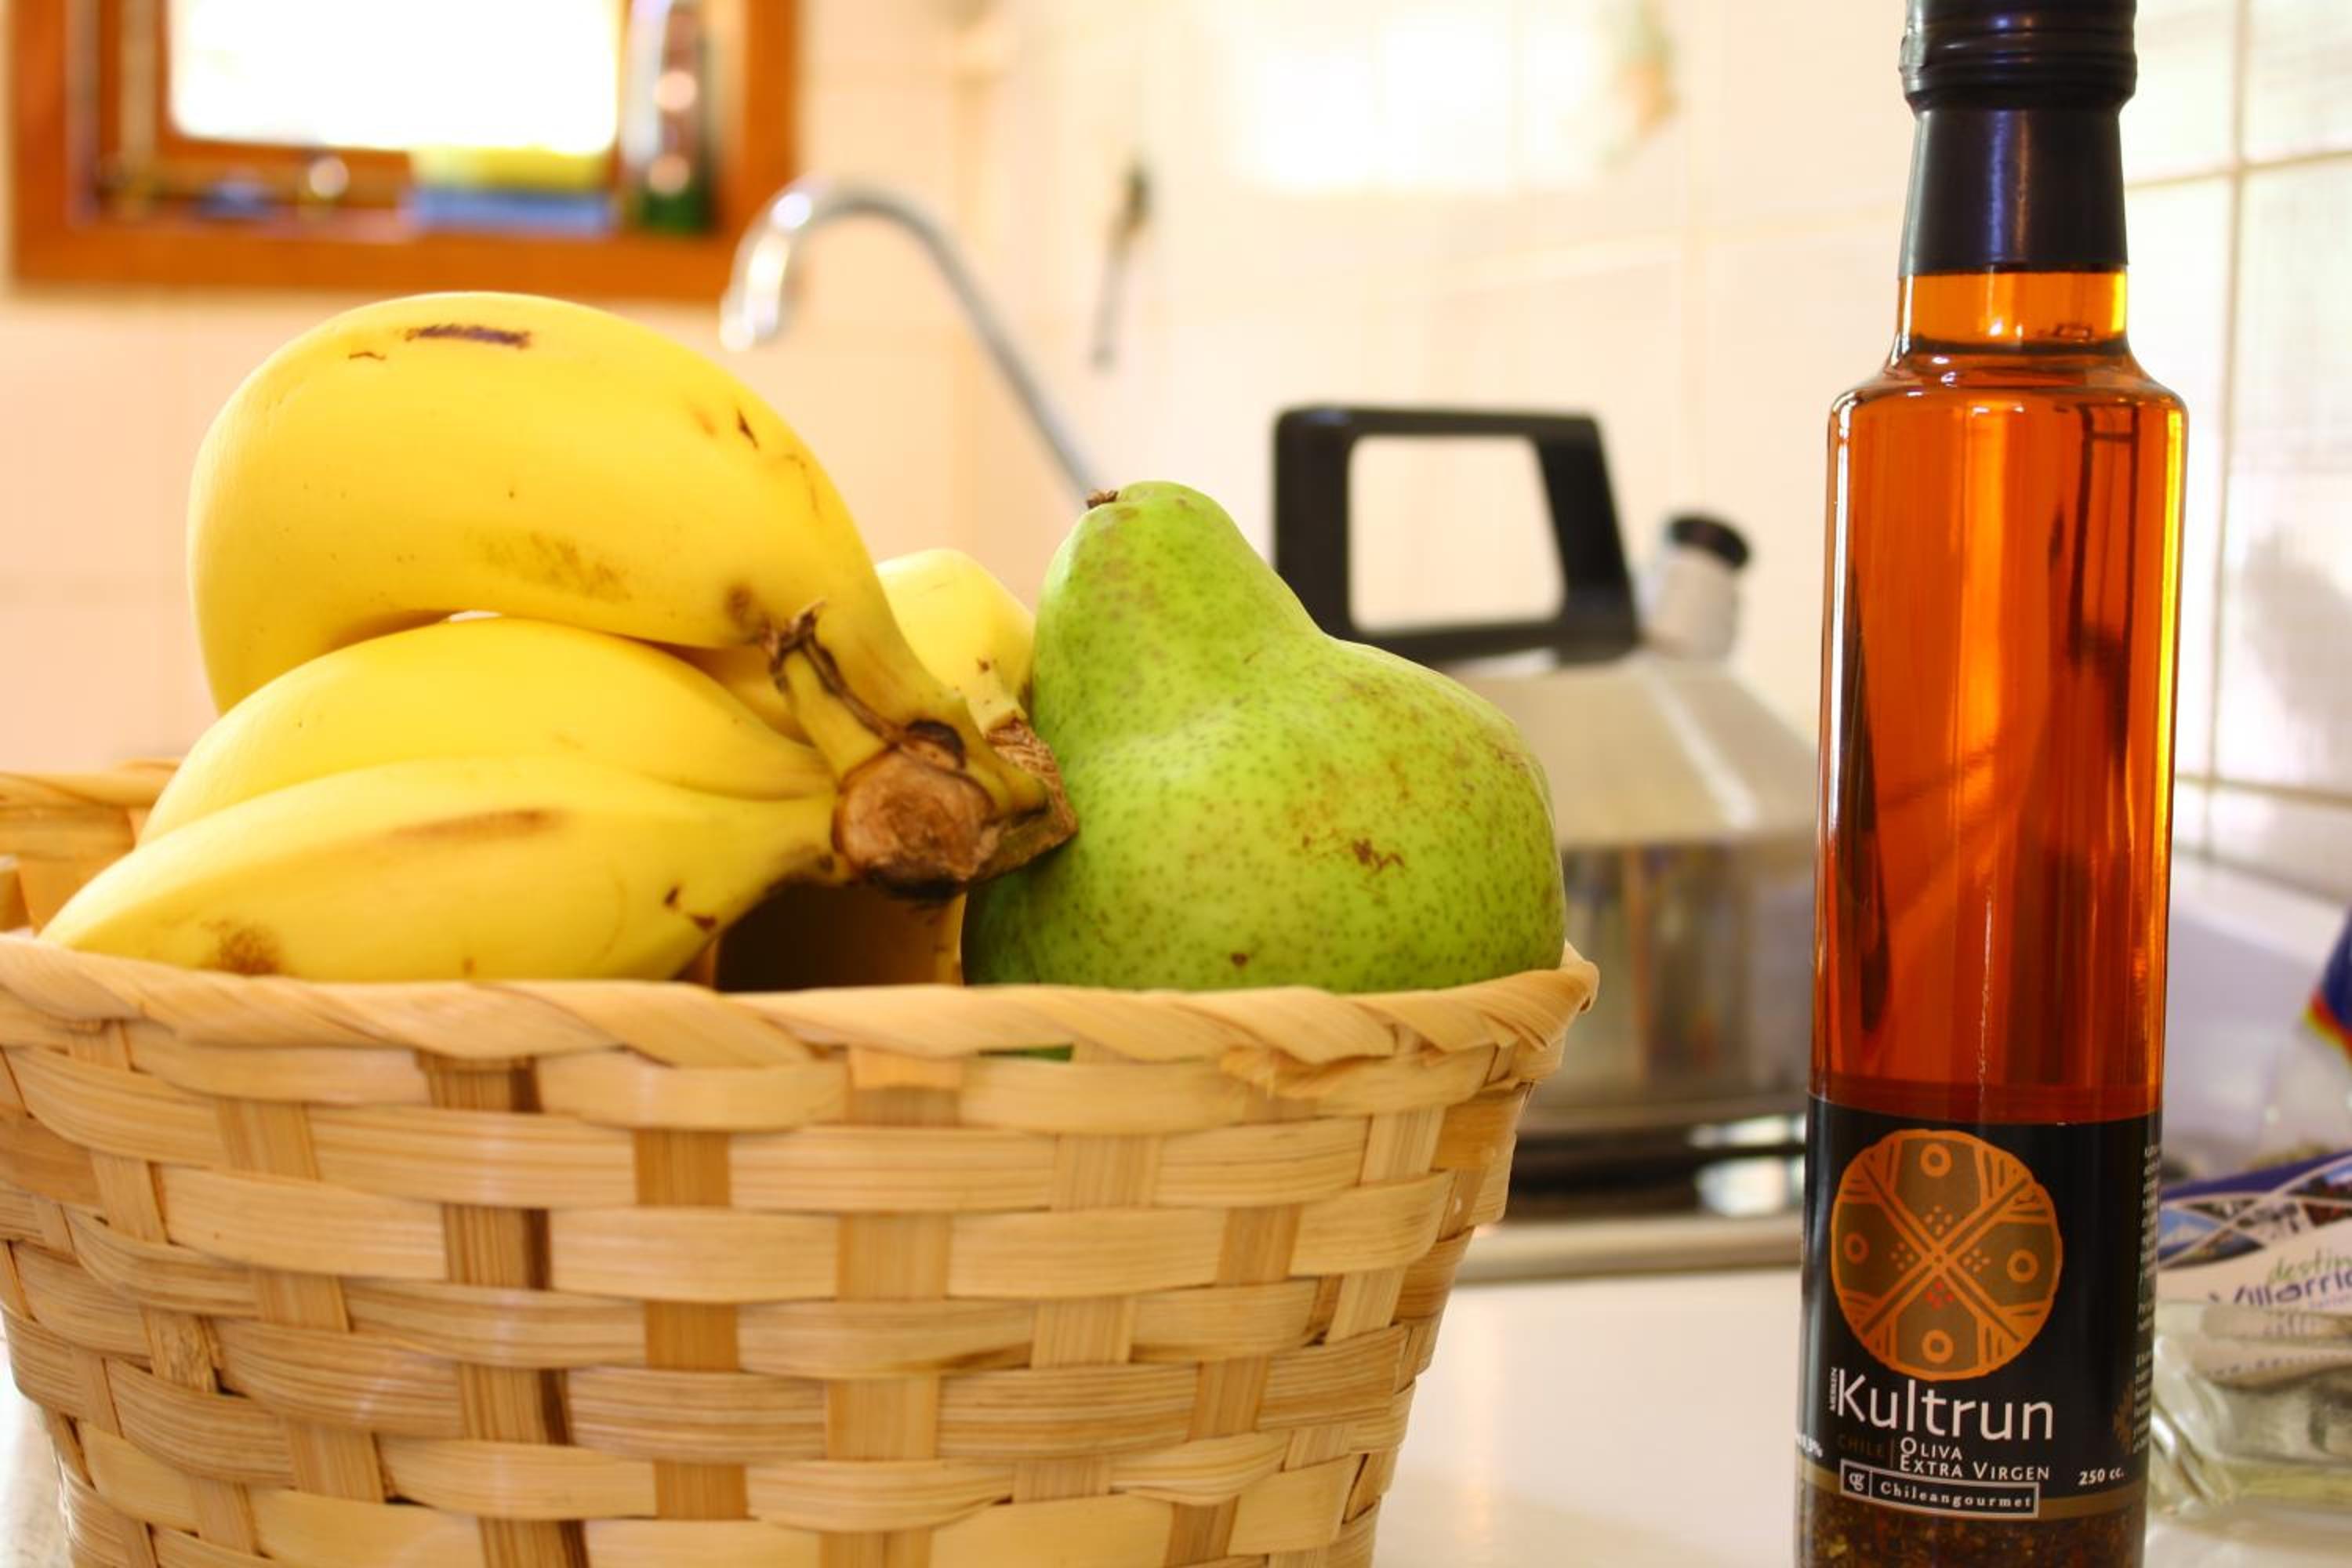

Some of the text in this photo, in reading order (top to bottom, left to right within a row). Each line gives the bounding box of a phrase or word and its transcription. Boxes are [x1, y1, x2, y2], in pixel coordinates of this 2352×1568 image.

[1838, 1368, 2053, 1440] Kultrun
[1900, 1436, 1963, 1460] OLIVA
[1900, 1454, 2050, 1481] EXTRA VIRGEN
[2078, 1468, 2106, 1486] 250
[1881, 1481, 2032, 1508] Chileangourmet
